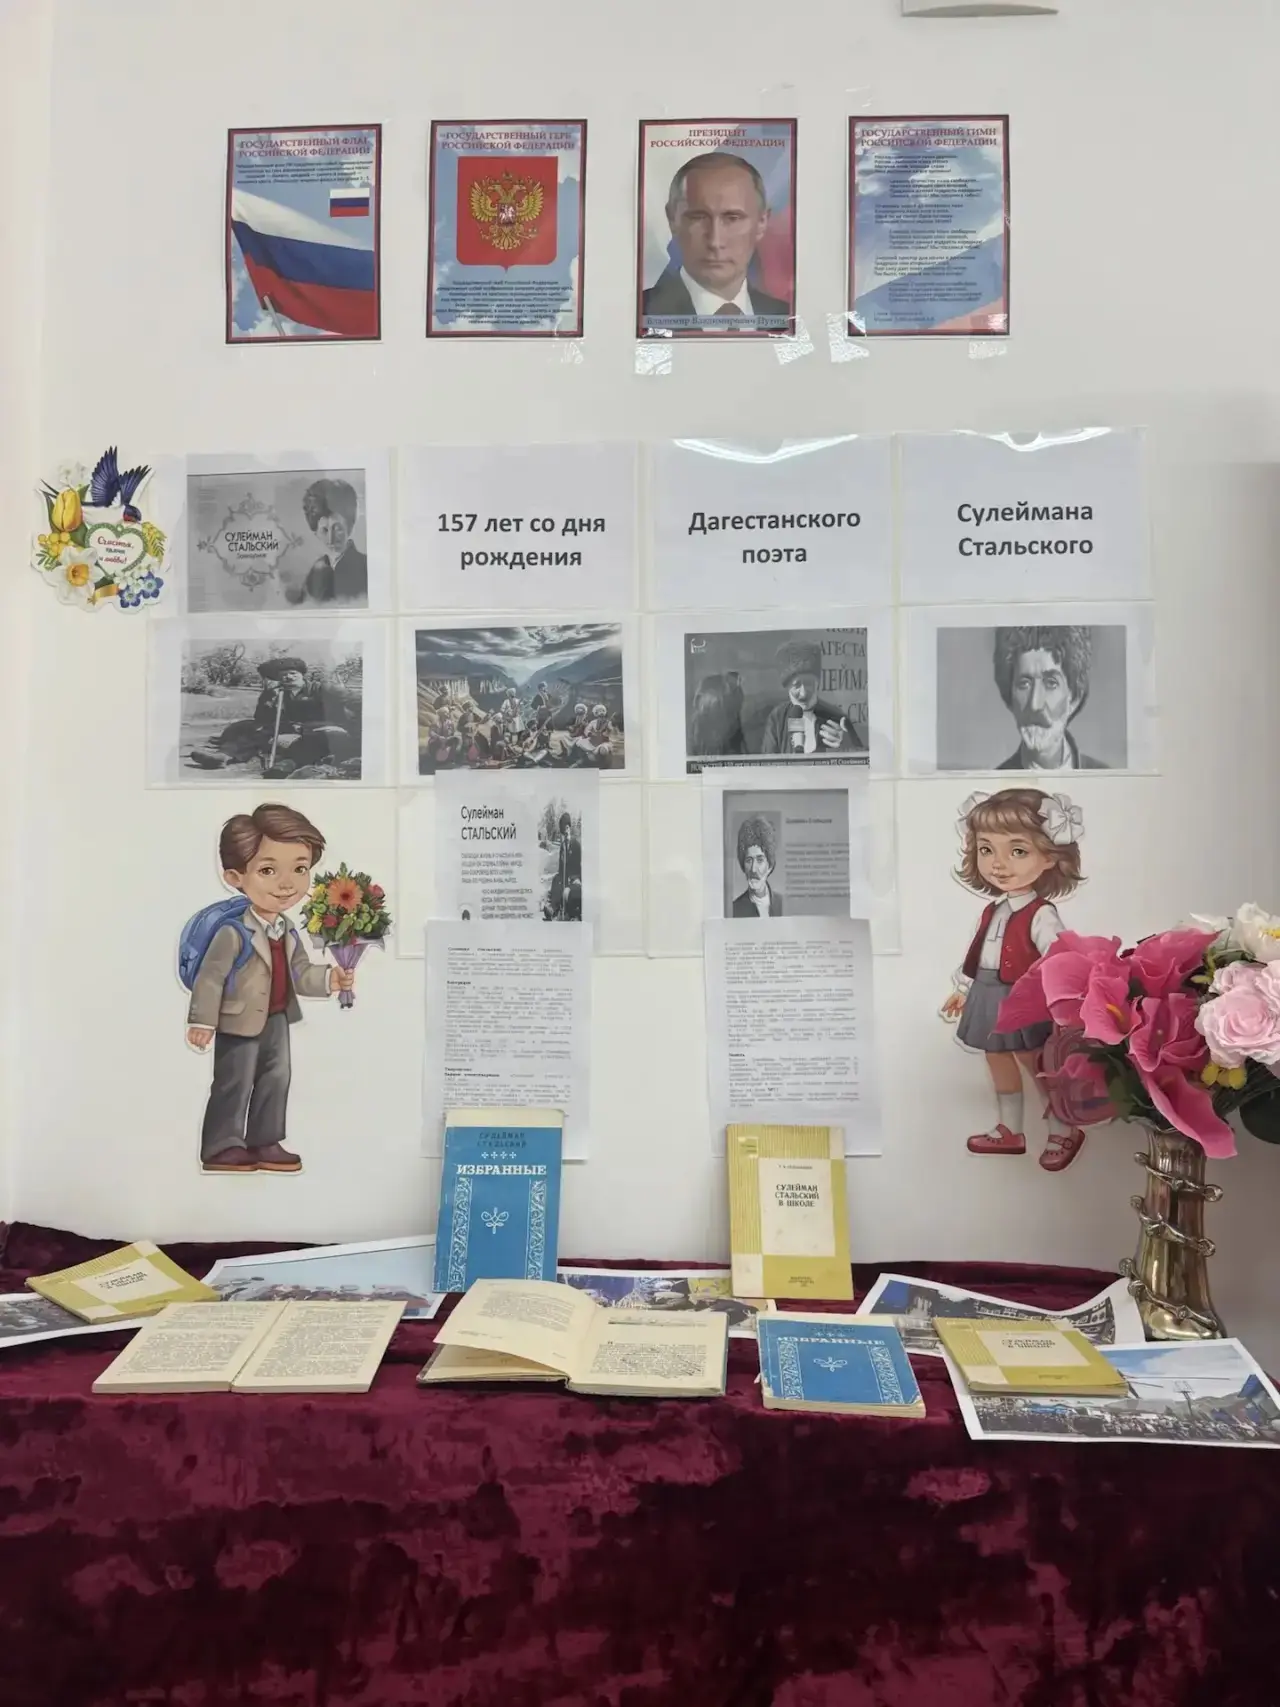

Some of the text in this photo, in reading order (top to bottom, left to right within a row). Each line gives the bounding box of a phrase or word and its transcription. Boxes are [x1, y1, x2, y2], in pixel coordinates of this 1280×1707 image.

[446, 131, 572, 141] ГОСУДАРСТВЕННЫЙ ГЕРБ
[689, 128, 747, 138] ПРЕЗИДЕНТ
[861, 127, 996, 138] ГОСУДАРСТВЕННЫЙ ГИМН
[240, 136, 368, 149] ГОСУДАРСТВЕННЫЙ ФЛАГ
[441, 140, 575, 150] РОССИЙСКОЙ ФЕДЕРАЦИИ
[650, 137, 785, 148] РОССИЙСКОЙ ФЕДЕРАЦИИ
[861, 138, 997, 147] РОССИЙСКОЙ ФЕДЕРАЦИИ
[239, 147, 370, 158] РОССИЙСКОЙ ФЕДЕРАЦИИ
[957, 501, 1094, 527] Сулеймана
[437, 513, 606, 537] 157 лет со дня
[688, 512, 861, 535] Дагестанского
[224, 530, 273, 542] СУЛЕЙМАН
[228, 539, 279, 552] СТАЛЬСКИЙ
[958, 537, 1094, 557] Стальского
[460, 551, 582, 571] рождения
[742, 547, 807, 564] поэта
[460, 804, 504, 822] Сулейман
[461, 823, 517, 841] СТАЛЬСКИЙ
[456, 1164, 547, 1176] ИЗБРАННЫЕ
[776, 1182, 818, 1192] СУЛЕЙМАН
[774, 1191, 820, 1200] СТАЛЬСКИЙ
[778, 1199, 816, 1208] В ШКОЛЕ
